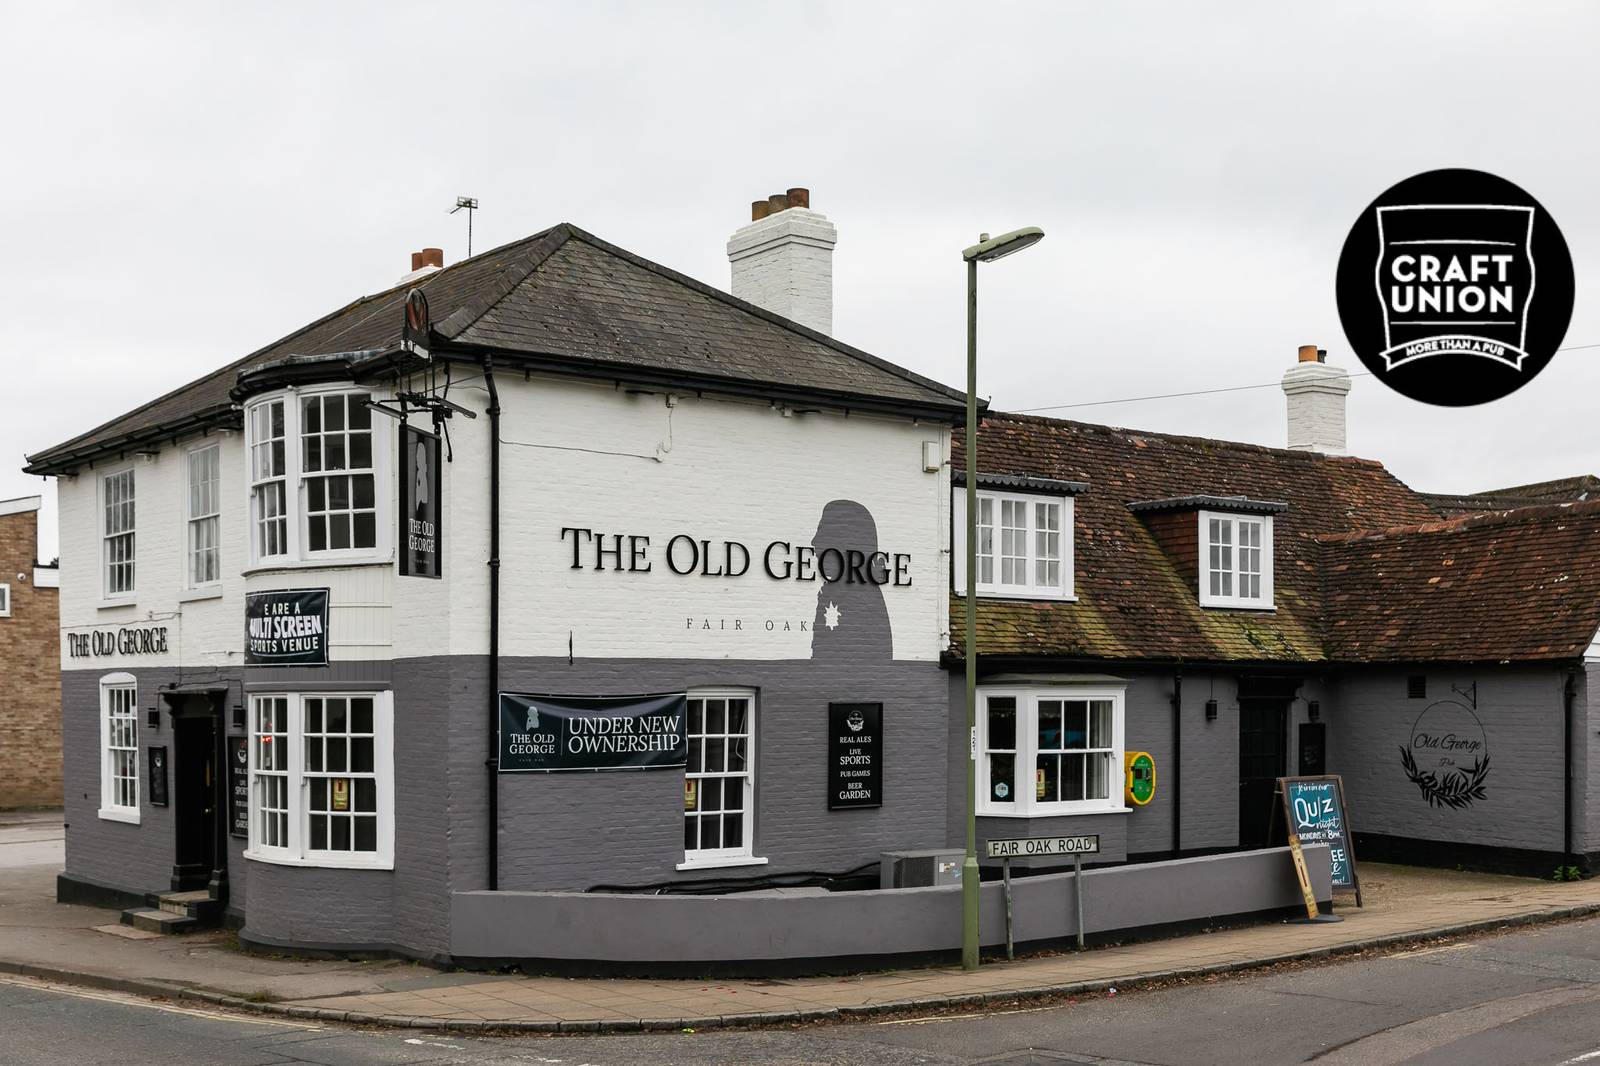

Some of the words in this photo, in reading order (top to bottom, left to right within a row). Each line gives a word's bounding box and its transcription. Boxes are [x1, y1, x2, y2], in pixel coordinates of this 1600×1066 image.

[409, 518, 422, 535] THE
[422, 520, 435, 537] OLD
[408, 534, 435, 553] GEORGE
[561, 527, 652, 573] THE
[666, 534, 751, 578] OLD
[763, 541, 913, 587] GEORGE
[272, 602, 289, 615] ARE
[294, 601, 301, 614] A
[273, 614, 323, 639] SCREEN
[686, 617, 743, 632] FAIR
[765, 619, 809, 633] OAK
[67, 632, 90, 658] THE
[92, 629, 115, 657] OLD
[117, 626, 168, 655] GEORGE
[250, 639, 278, 653] SPORTS
[281, 636, 319, 652] VENUE
[568, 716, 634, 735] UNDER
[638, 715, 681, 734] NEW
[510, 733, 531, 744] THE
[532, 733, 555, 744] OLD
[567, 733, 681, 754] OWNERSHIP
[1413, 732, 1440, 750] Old
[1440, 733, 1482, 754] George
[509, 744, 556, 755] GEORGE
[849, 748, 862, 756] LIVE
[840, 756, 871, 765] SPORTS
[839, 790, 871, 799] GARDEN
[992, 842, 1019, 856] FAIR
[1025, 840, 1052, 854] OAK
[1058, 837, 1093, 852] ROAD
